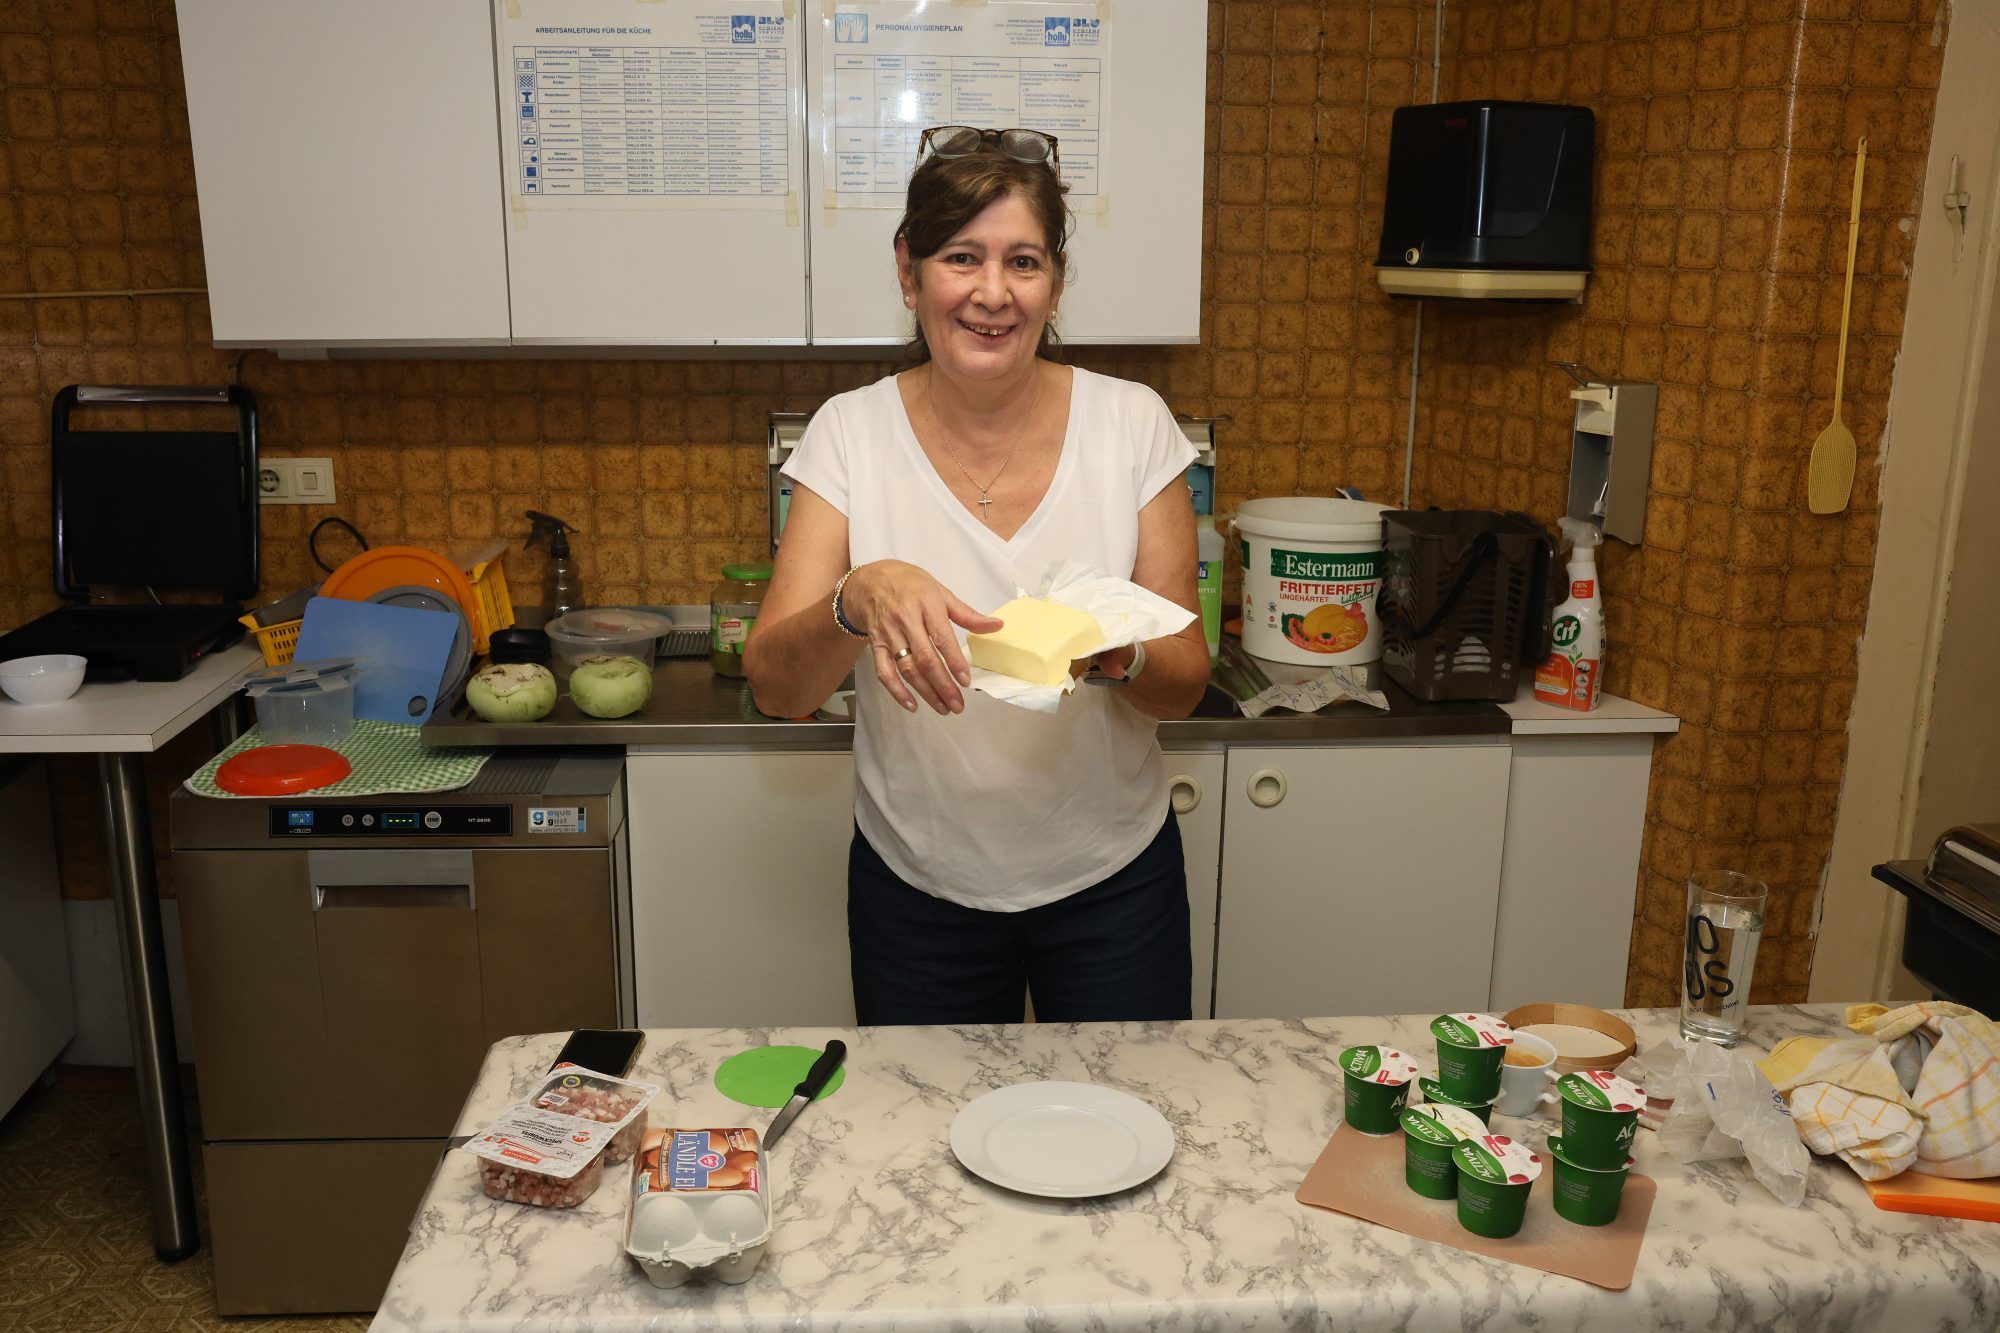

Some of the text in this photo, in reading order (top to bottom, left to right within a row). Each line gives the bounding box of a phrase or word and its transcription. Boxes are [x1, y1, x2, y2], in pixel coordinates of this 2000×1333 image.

[602, 26, 616, 34] FÜR
[629, 26, 652, 34] KÜCHE
[734, 28, 753, 39] hollu
[1047, 32, 1067, 42] hollu
[1285, 555, 1374, 578] Estermann
[1280, 581, 1376, 595] FRITTIERFETT
[1280, 594, 1329, 603] UNGEHÄRTET
[1553, 620, 1578, 641] Cif
[1564, 1079, 1599, 1106] ACTIVIA
[1406, 1115, 1443, 1141] ACTIVIA
[675, 1133, 700, 1187] LÄNDLE EI
[1461, 1147, 1495, 1178] ACTIVIA
